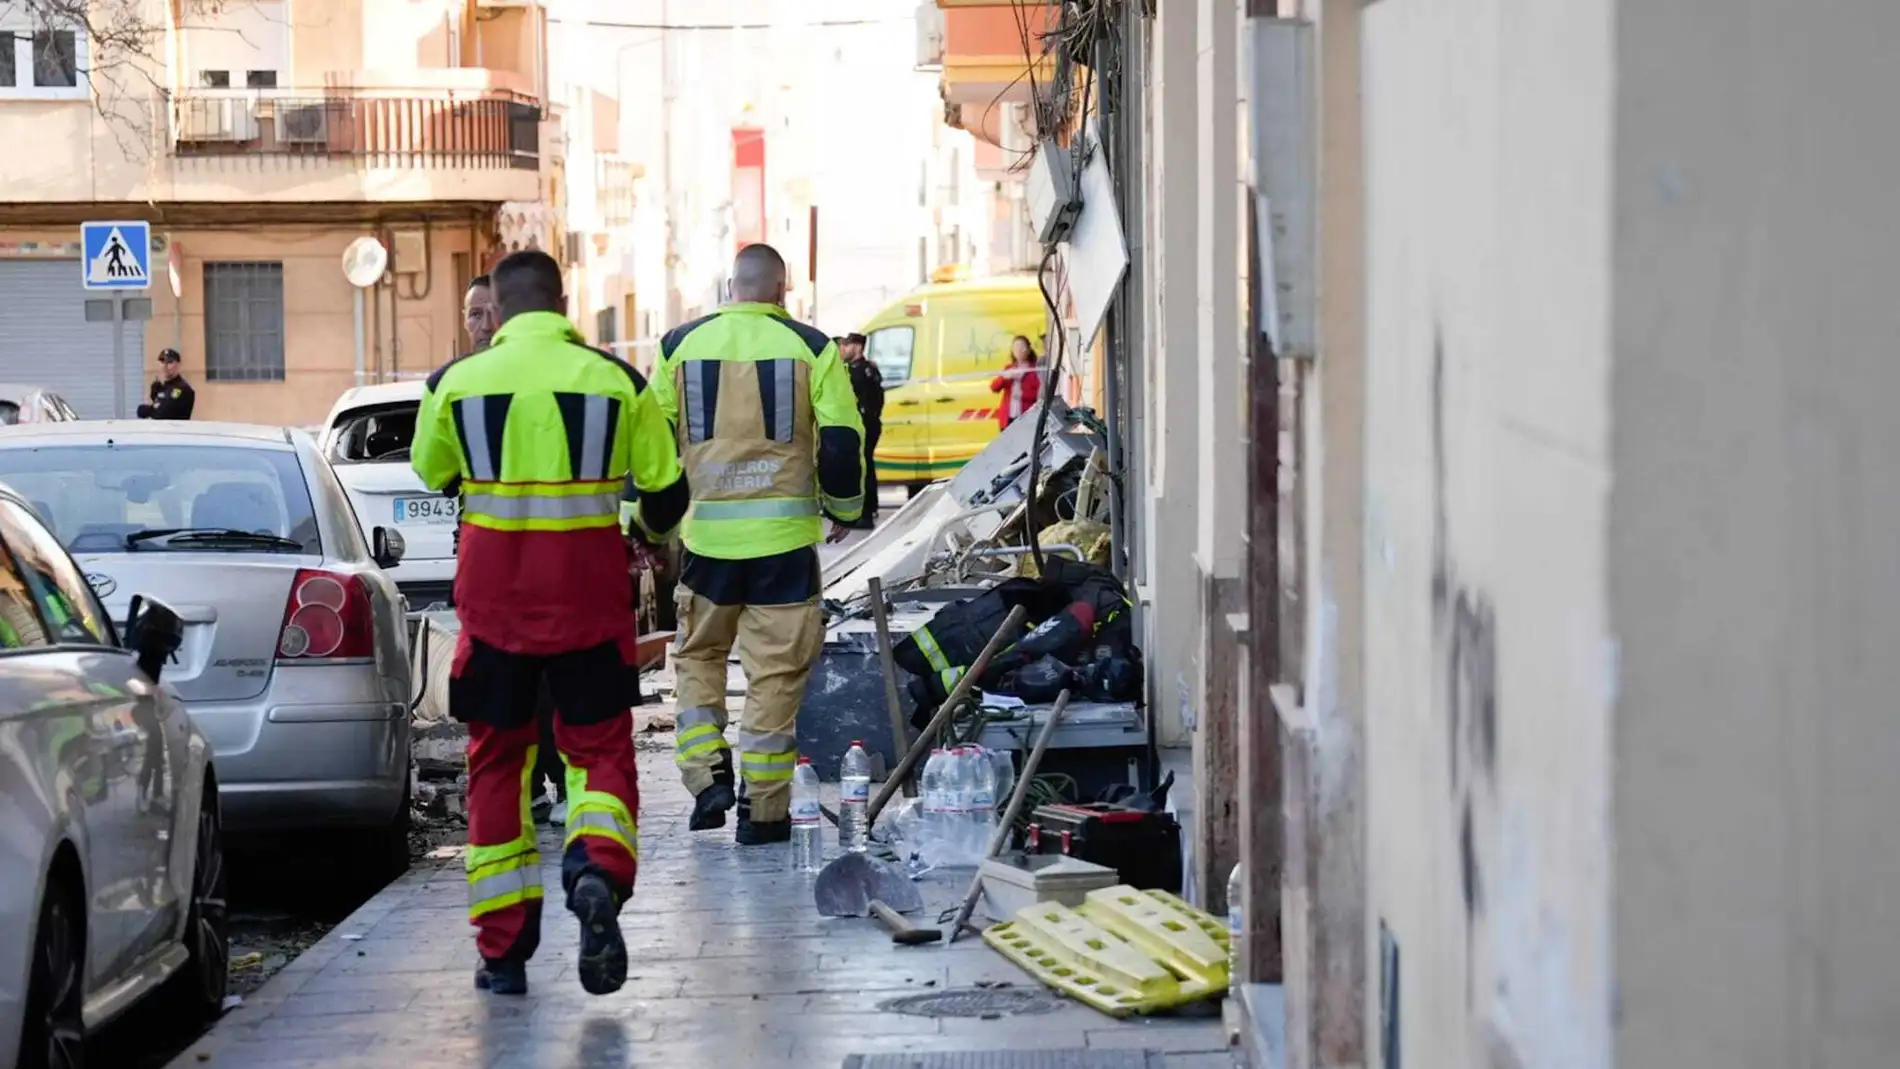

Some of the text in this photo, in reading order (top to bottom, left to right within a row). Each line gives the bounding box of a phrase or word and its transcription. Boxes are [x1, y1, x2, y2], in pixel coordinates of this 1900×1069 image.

[698, 459, 781, 475] BEROS
[702, 475, 774, 490] LMERIA
[408, 500, 456, 518] 9943
